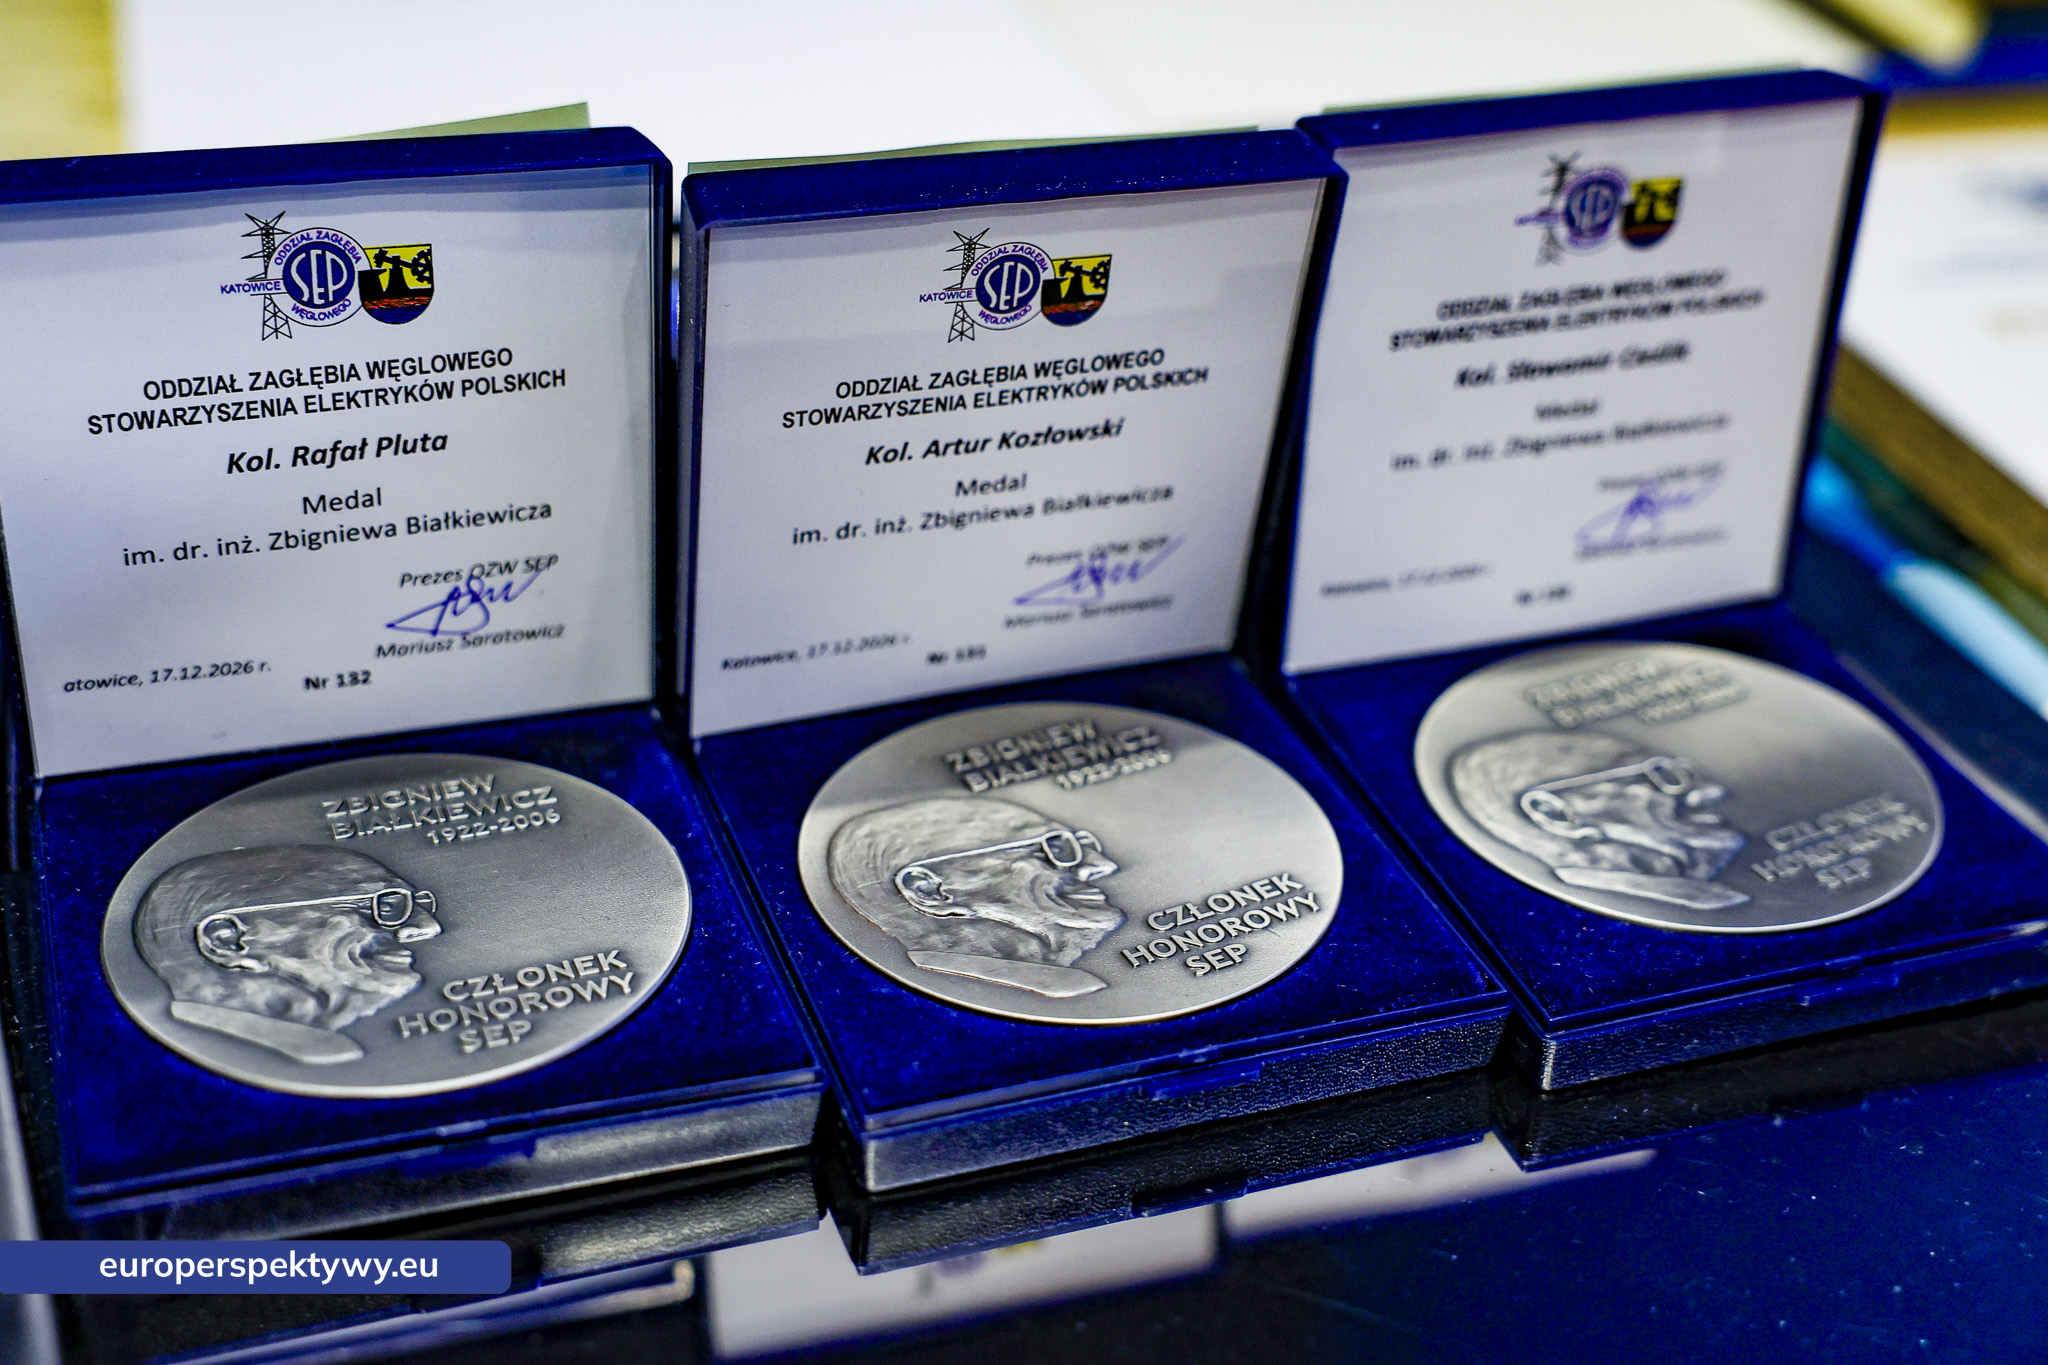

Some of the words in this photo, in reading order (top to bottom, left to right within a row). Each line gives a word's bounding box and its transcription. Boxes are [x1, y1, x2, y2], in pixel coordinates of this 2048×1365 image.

[274, 230, 313, 266] ODDZIAŁ
[316, 230, 362, 264] ZAGŁĘBIA
[971, 246, 1009, 276] ODDZIAŁ
[1012, 245, 1049, 273] ZAGŁĘBIA
[220, 280, 281, 294] KATOWICE
[290, 249, 348, 305] SEP
[919, 290, 973, 302] KATOWICE
[983, 261, 1034, 311] SEP
[291, 298, 352, 321] WĘGLOWEGO
[143, 371, 243, 401] ODDZIAŁ
[248, 363, 361, 393] ZAGŁĘBIA
[366, 347, 514, 381] WĘGLOWEGO
[836, 374, 922, 399] ODDZIAŁ
[927, 364, 1029, 393] ZAGŁĘBIA
[1034, 348, 1166, 380] WĘGLOWEGO
[88, 397, 298, 435] STOWARZYSZENIA
[304, 380, 454, 414] ELEKTRYKÓW
[461, 369, 567, 398] POLSKICH
[782, 395, 967, 429] STOWARZYSZENIA
[973, 379, 1106, 410] ELEKTRYKÓW
[1112, 367, 1210, 394] POLSKICH
[226, 450, 281, 474] Kol.
[291, 437, 369, 471] Rafał
[375, 432, 448, 458] Pluta
[865, 443, 912, 466] Kol.
[922, 437, 992, 459] Artur
[998, 418, 1126, 451] Kozłowski
[302, 487, 383, 514] Medal
[955, 472, 1028, 497] Medal
[122, 547, 165, 567] im.
[173, 539, 208, 561] dr.
[217, 535, 261, 558] inż.
[268, 520, 398, 551] Zbigniewa
[406, 501, 552, 535] Białkiewicza
[792, 528, 828, 545] im.
[836, 521, 866, 541] dr.
[874, 516, 911, 534] inż.
[920, 502, 1035, 531] Zbigniewa
[400, 567, 463, 589] Prezes
[470, 560, 519, 578] OZW
[375, 638, 453, 659] Mariusz
[64, 673, 144, 693] atowice,
[150, 659, 255, 684] 17.12.2026
[304, 676, 329, 691] Nr
[336, 669, 372, 687] 132
[322, 775, 496, 818] ZBIGNIEW
[331, 785, 559, 841] BIAŁKIEWICZ
[426, 809, 561, 844] 1922-2006
[1147, 873, 1308, 935] CZŁONEK
[1121, 893, 1322, 969] HONOROWY
[443, 949, 628, 1001] CZŁONEK
[1185, 943, 1249, 978] SEP
[398, 972, 636, 1038] HONOROWY
[460, 1020, 532, 1053] SEP
